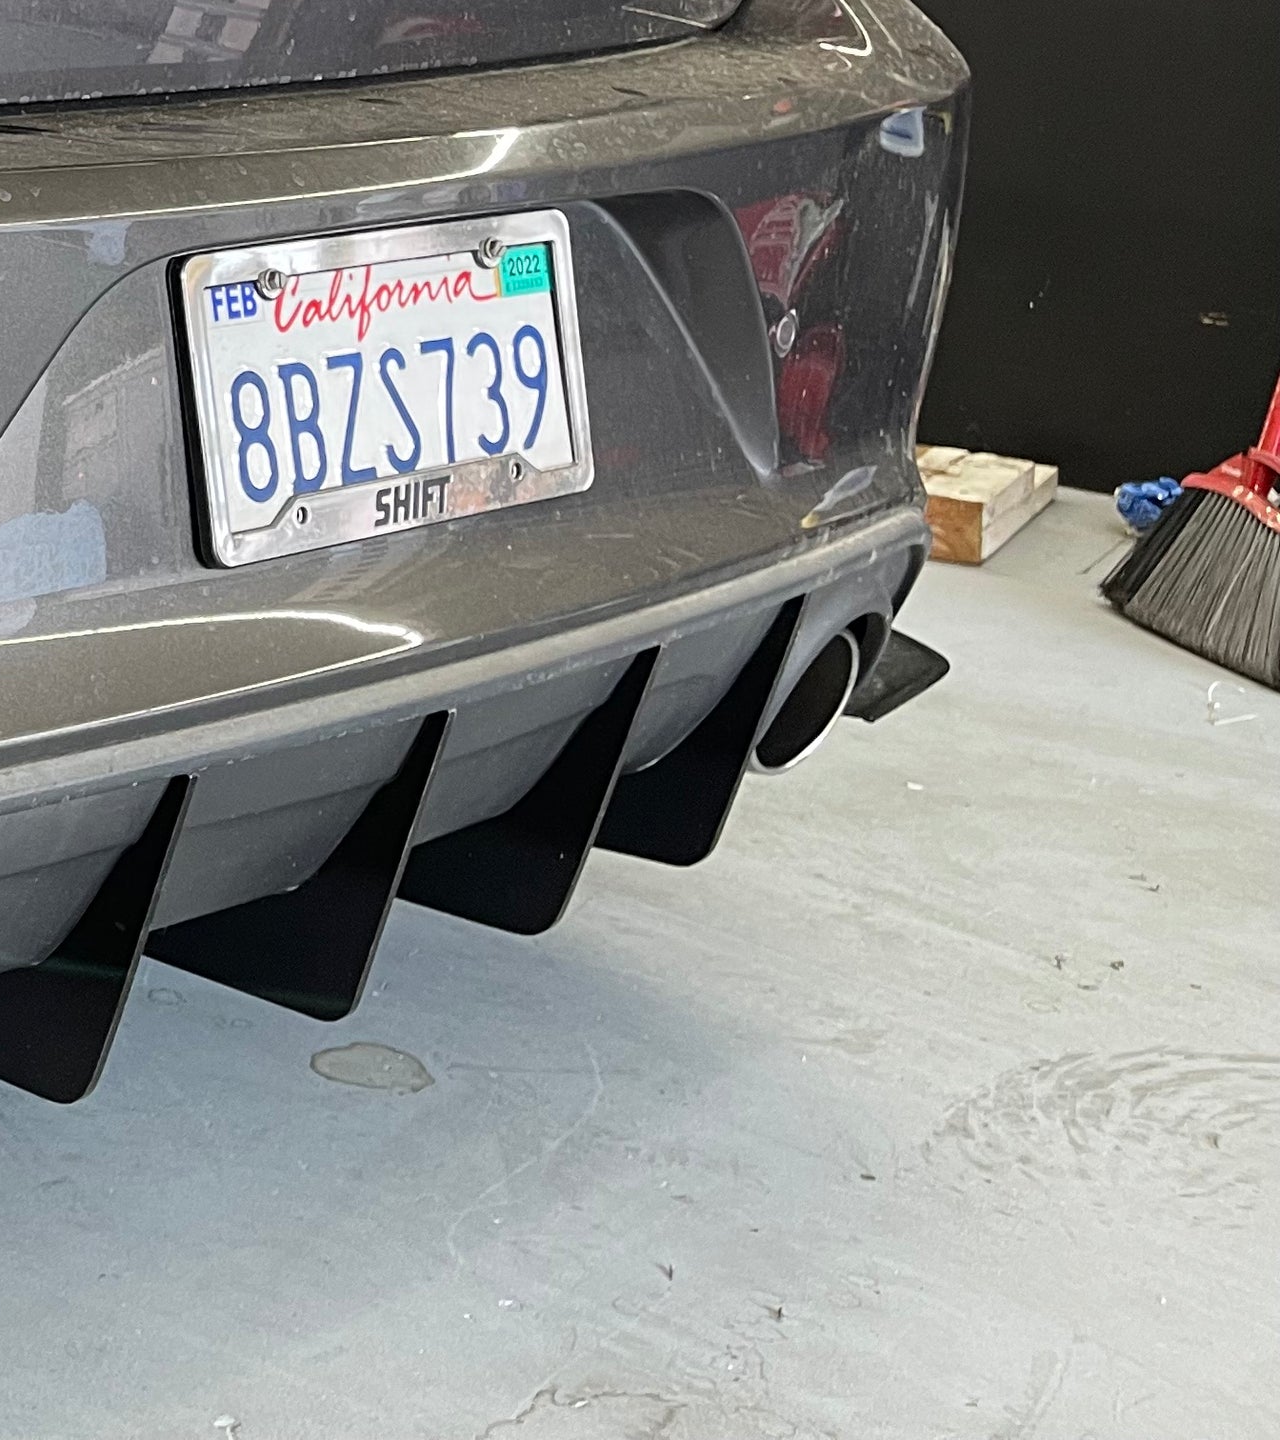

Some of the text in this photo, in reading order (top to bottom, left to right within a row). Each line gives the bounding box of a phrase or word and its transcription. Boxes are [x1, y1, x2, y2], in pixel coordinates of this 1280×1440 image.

[507, 254, 541, 277] 2022
[210, 264, 497, 342] FEB California
[230, 324, 548, 503] 8BZS739
[374, 476, 452, 528] SHIFT
